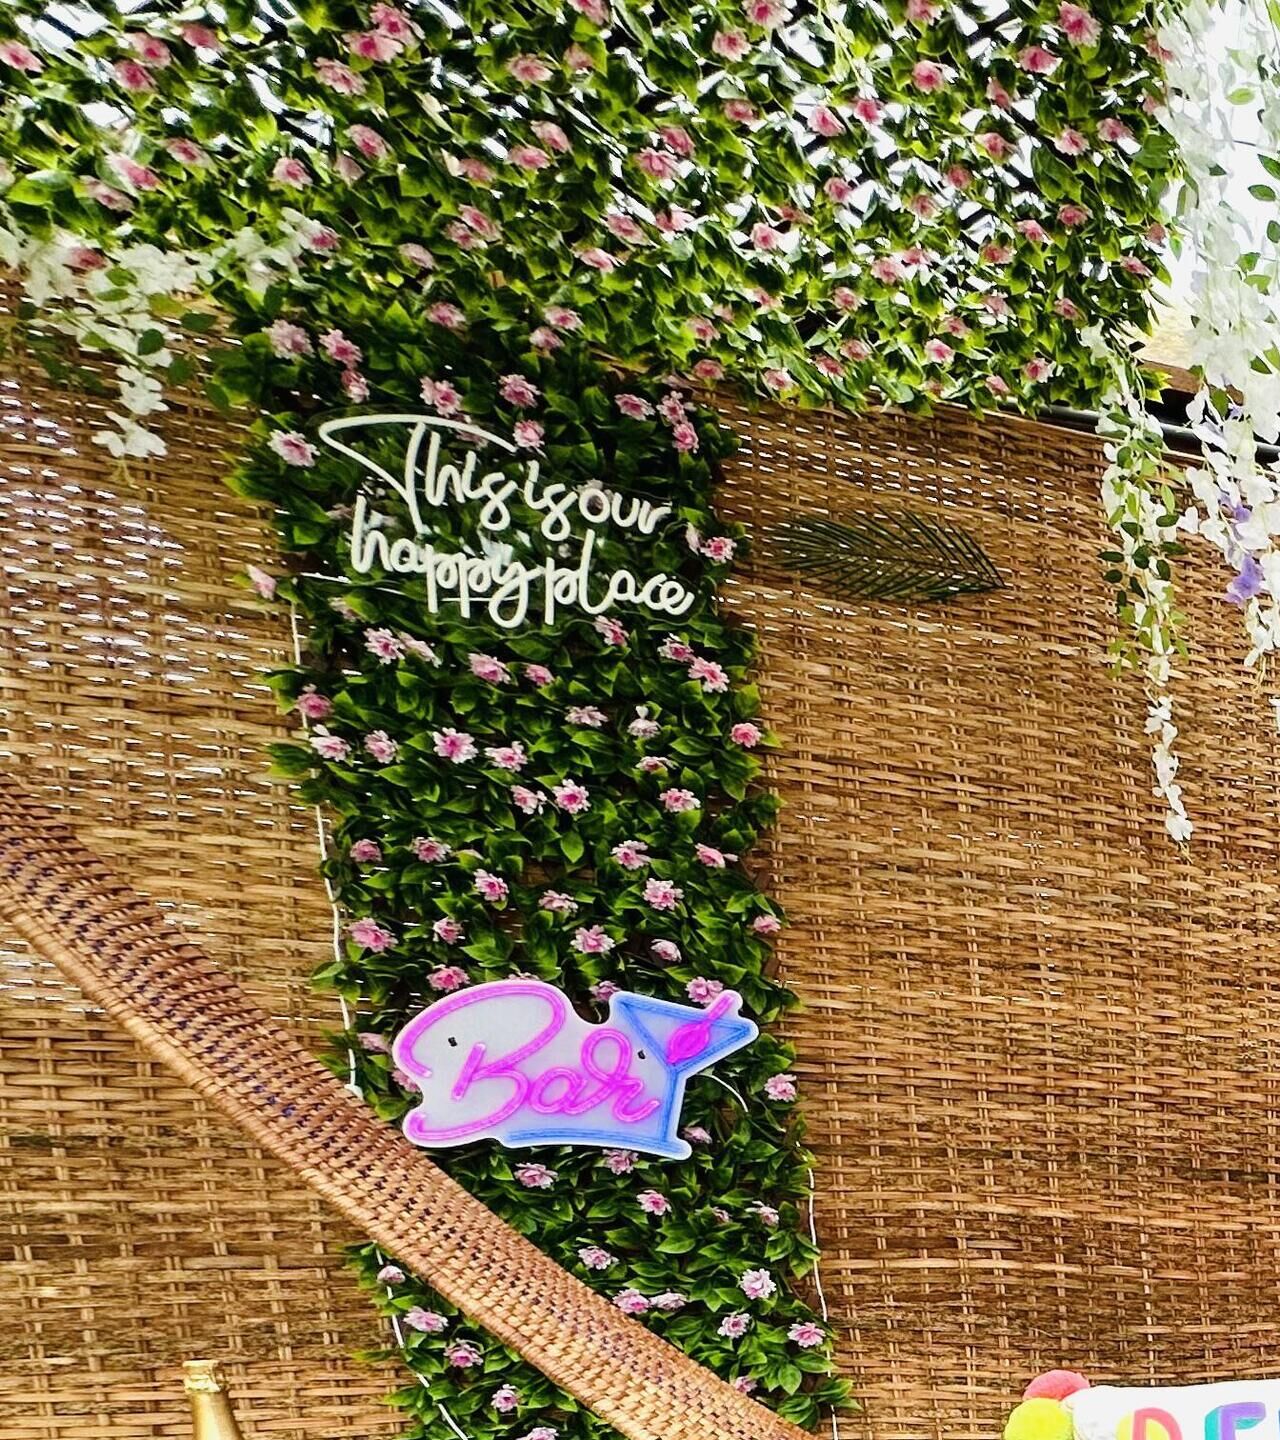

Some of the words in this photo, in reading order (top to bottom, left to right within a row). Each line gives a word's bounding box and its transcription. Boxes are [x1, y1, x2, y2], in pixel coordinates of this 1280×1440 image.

[318, 413, 523, 534] This
[524, 459, 578, 542] is
[578, 486, 671, 535] our
[350, 494, 543, 628] happy
[544, 529, 695, 625] place
[399, 983, 660, 1141] Bar
